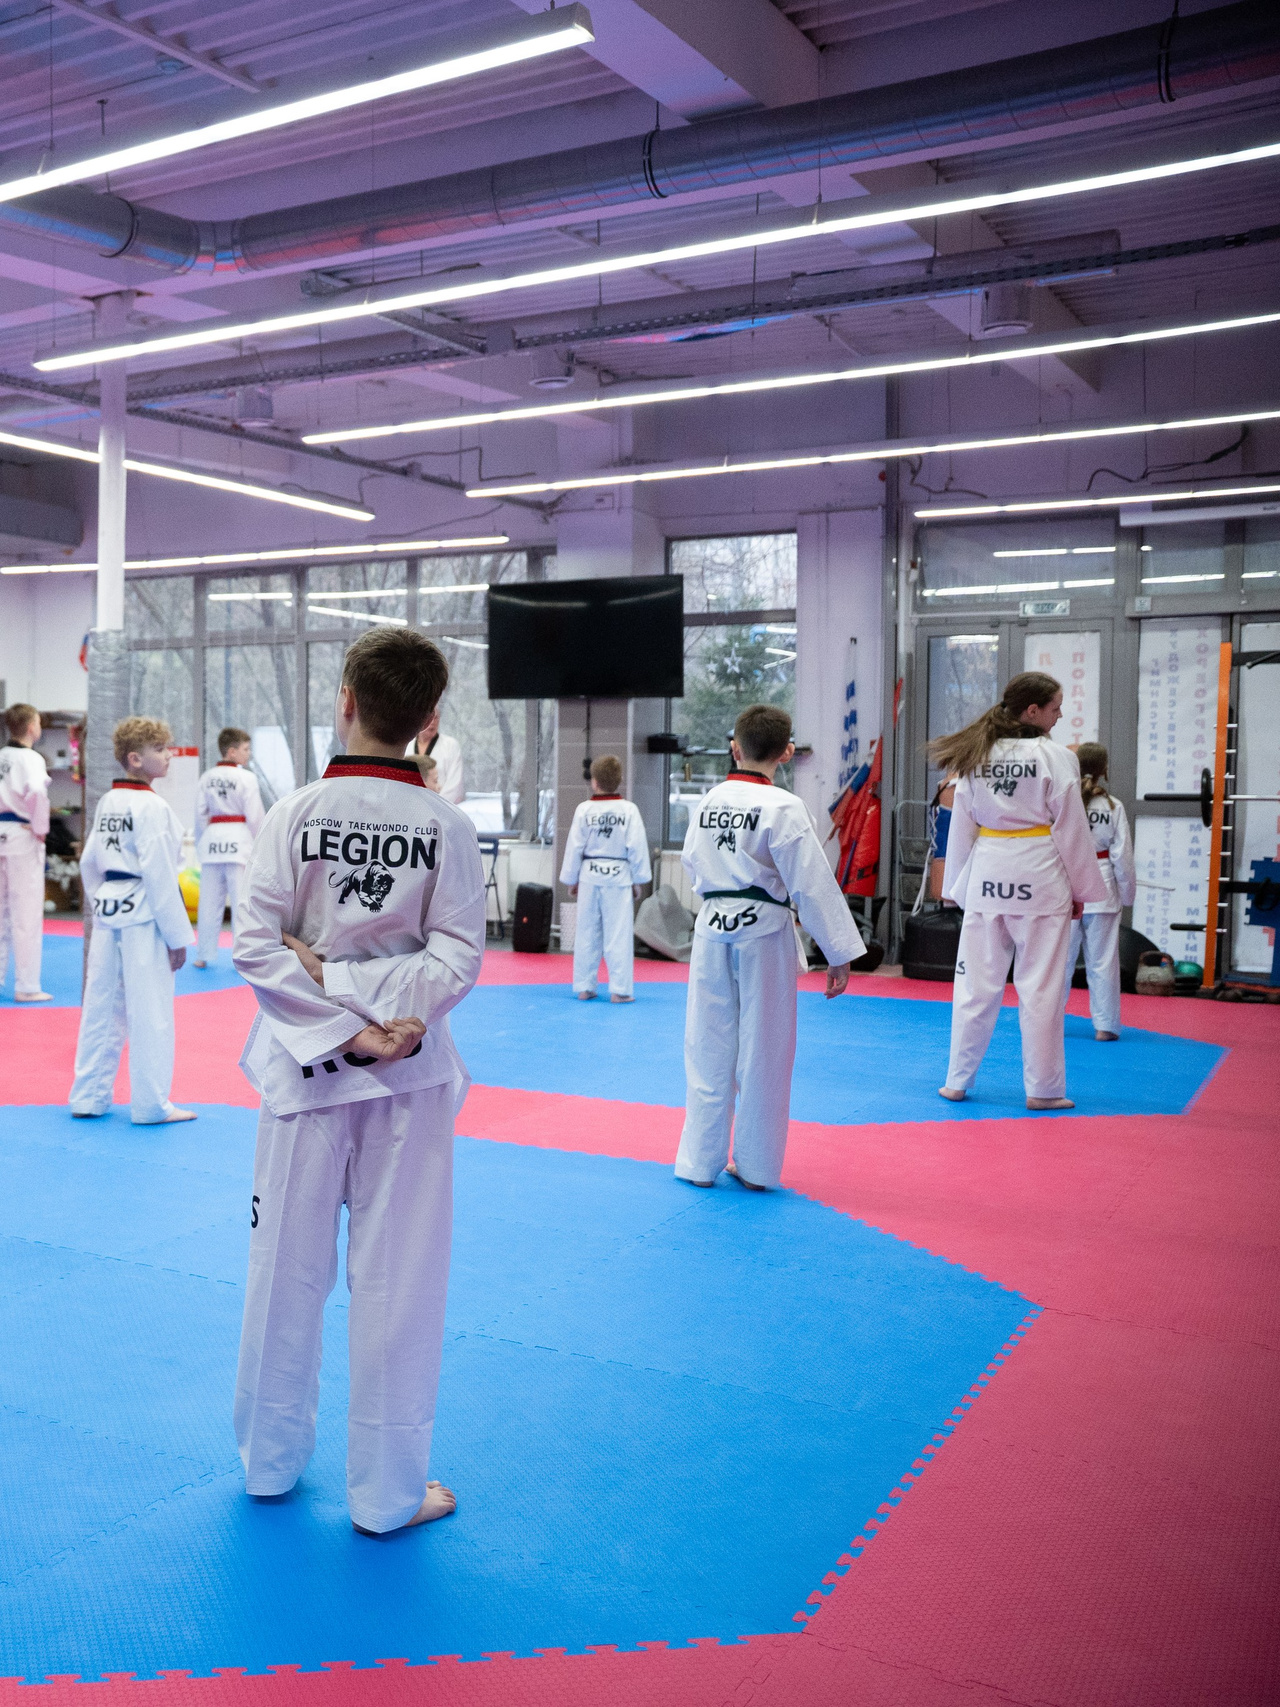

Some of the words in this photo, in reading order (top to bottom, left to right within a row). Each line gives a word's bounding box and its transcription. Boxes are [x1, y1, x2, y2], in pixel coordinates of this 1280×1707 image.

[974, 764, 1037, 778] LEGION
[303, 819, 343, 829] MOSCOW
[348, 821, 409, 834] TAEKWONDO
[414, 826, 439, 837] CLUB
[586, 814, 626, 827] LEGION
[209, 842, 238, 854] RUS
[301, 831, 438, 870] LEGION
[982, 881, 1033, 900] RUS
